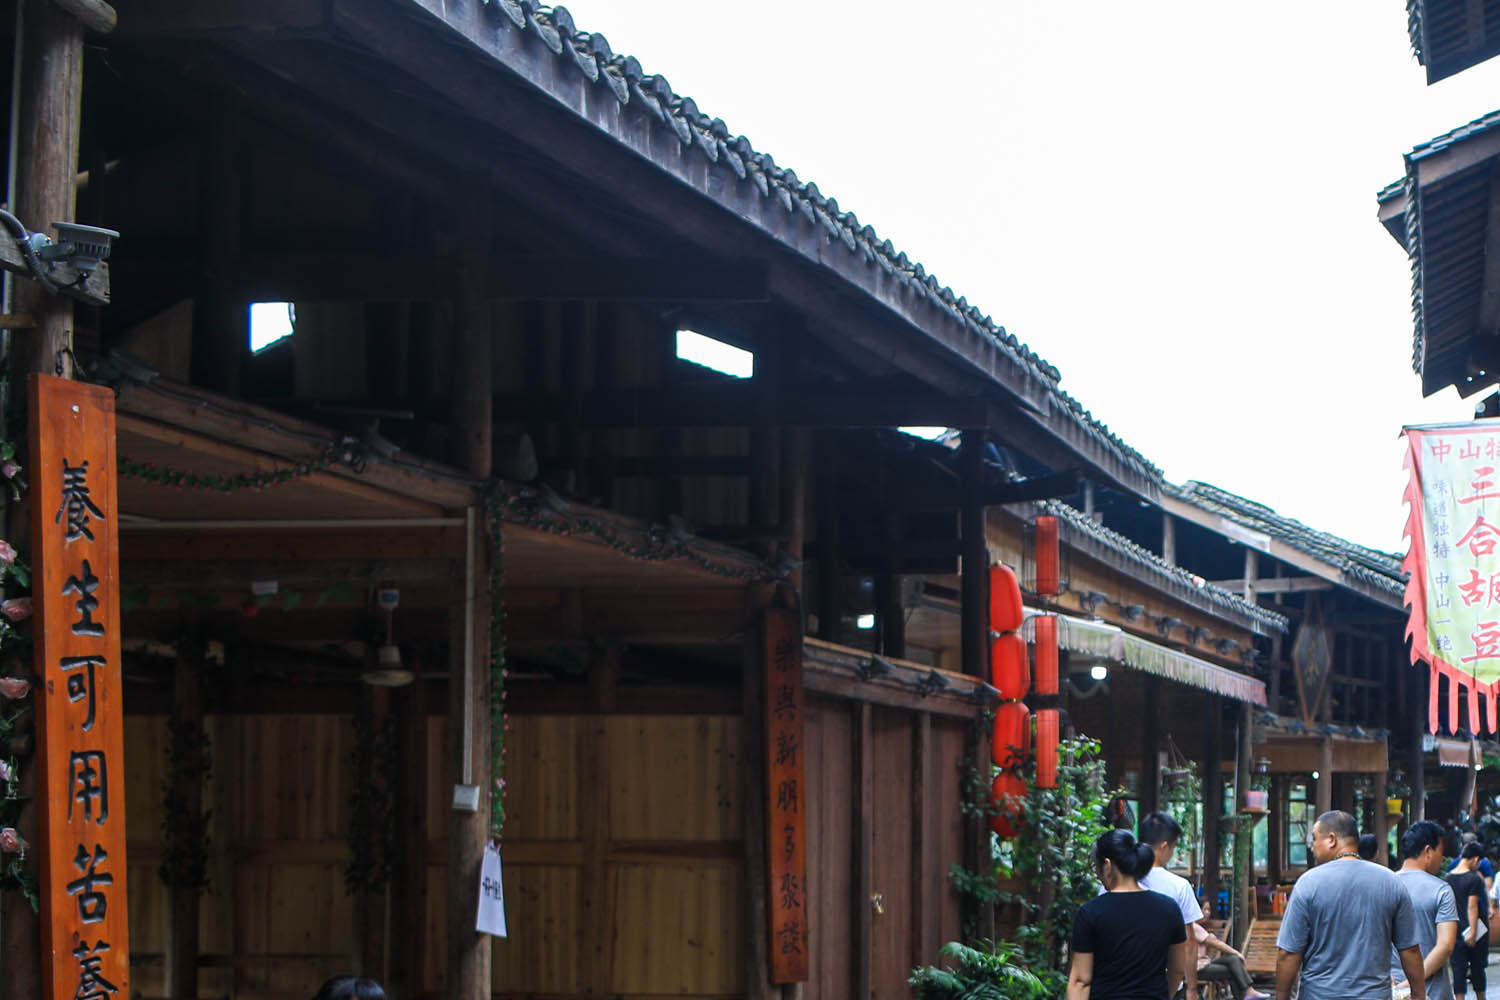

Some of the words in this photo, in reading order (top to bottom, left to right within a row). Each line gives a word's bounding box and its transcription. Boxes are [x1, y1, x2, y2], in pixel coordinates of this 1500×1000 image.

[1432, 480, 1450, 560] 味道独特
[1434, 571, 1452, 650] 中山一绝
